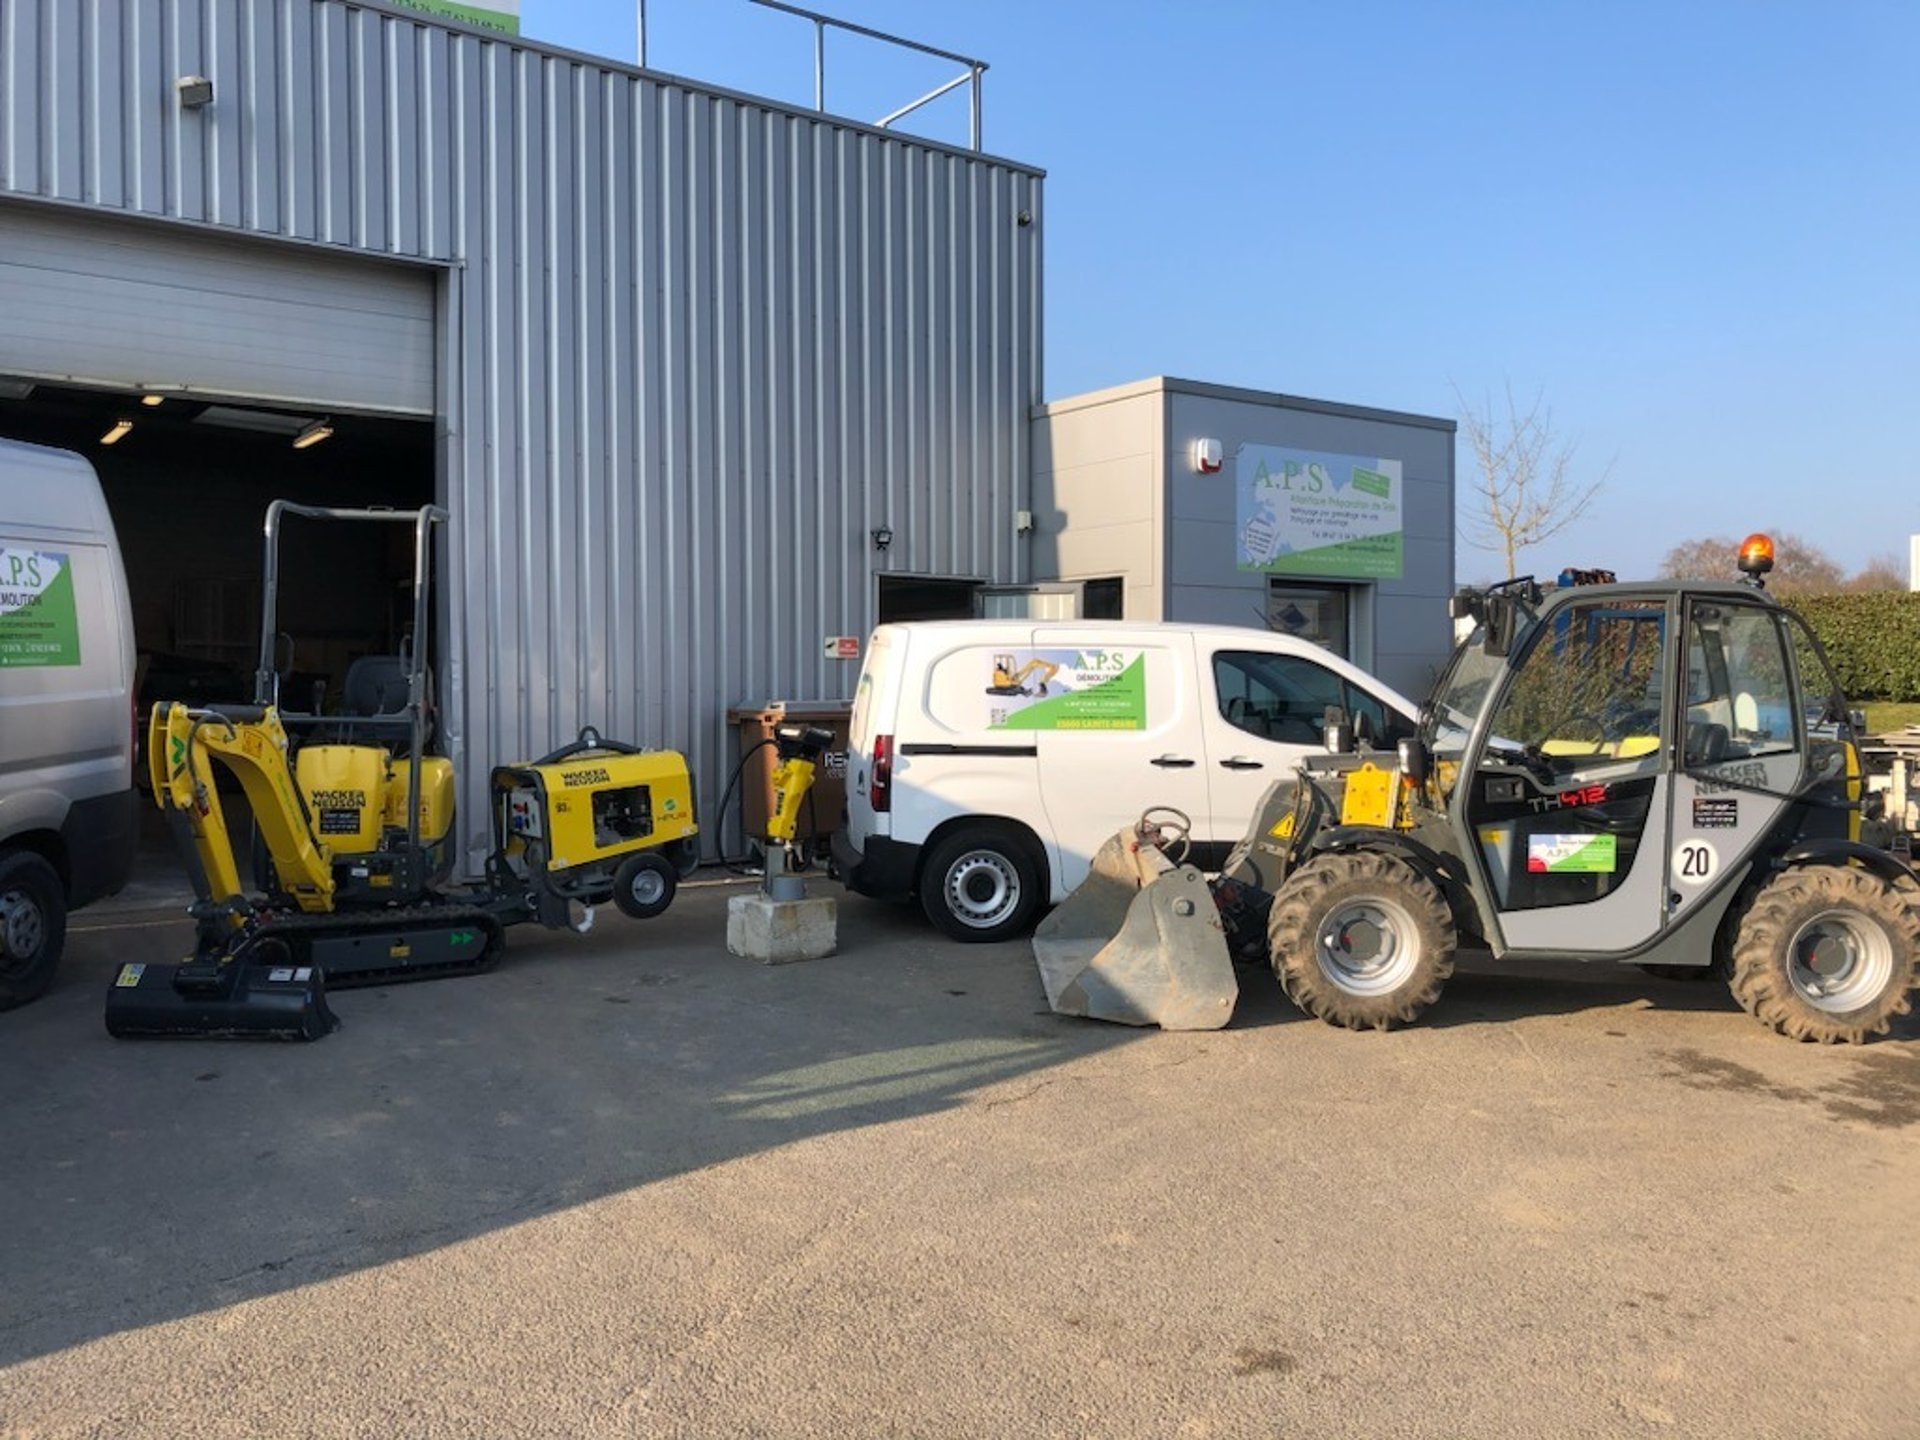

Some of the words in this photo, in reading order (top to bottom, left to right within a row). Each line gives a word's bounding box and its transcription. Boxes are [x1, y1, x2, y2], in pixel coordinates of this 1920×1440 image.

[1253, 457, 1323, 493] A.P.S
[0, 554, 42, 587] .P.S
[1072, 653, 1124, 670] A.P.S
[561, 769, 606, 779] WACKER
[565, 776, 610, 786] NEUSON
[312, 790, 364, 800] WACKER
[312, 799, 366, 808] NEUSON
[1682, 847, 1709, 876] 20
